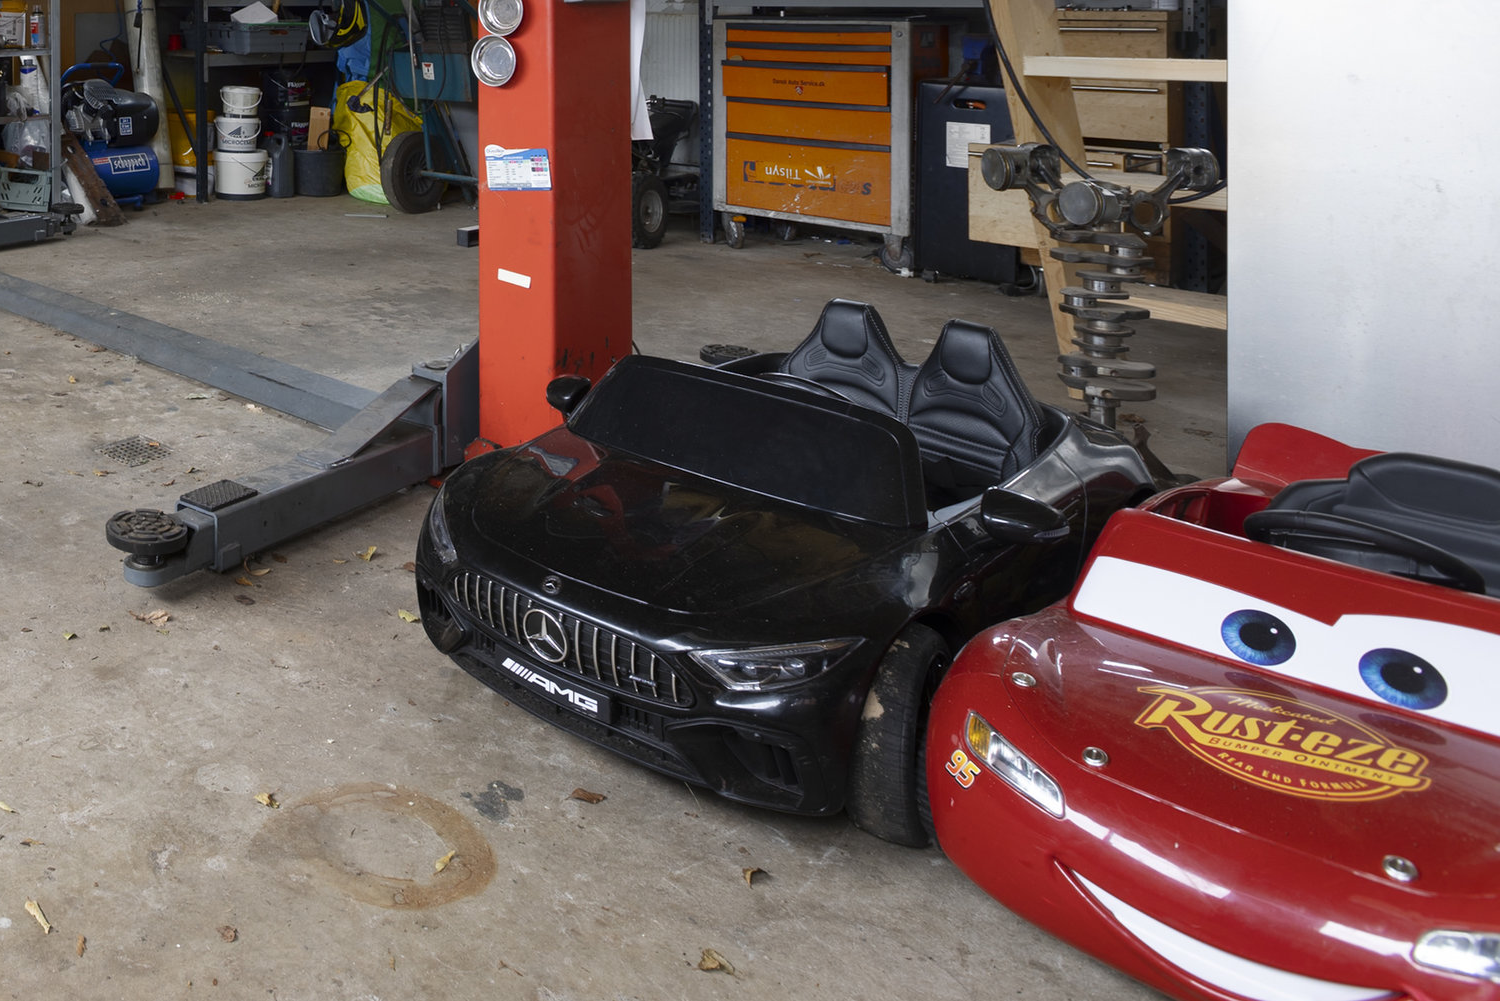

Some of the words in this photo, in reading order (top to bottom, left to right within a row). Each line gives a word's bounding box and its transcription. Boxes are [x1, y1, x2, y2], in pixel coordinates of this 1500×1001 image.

[114, 154, 146, 172] scheppach
[765, 164, 801, 180] Tilsyn
[528, 672, 599, 713] AMG
[1227, 694, 1341, 726] Medicated
[945, 749, 982, 789] 95
[1217, 751, 1254, 773] REAR
[1261, 770, 1292, 785] END
[1299, 777, 1369, 790] FORMULA
